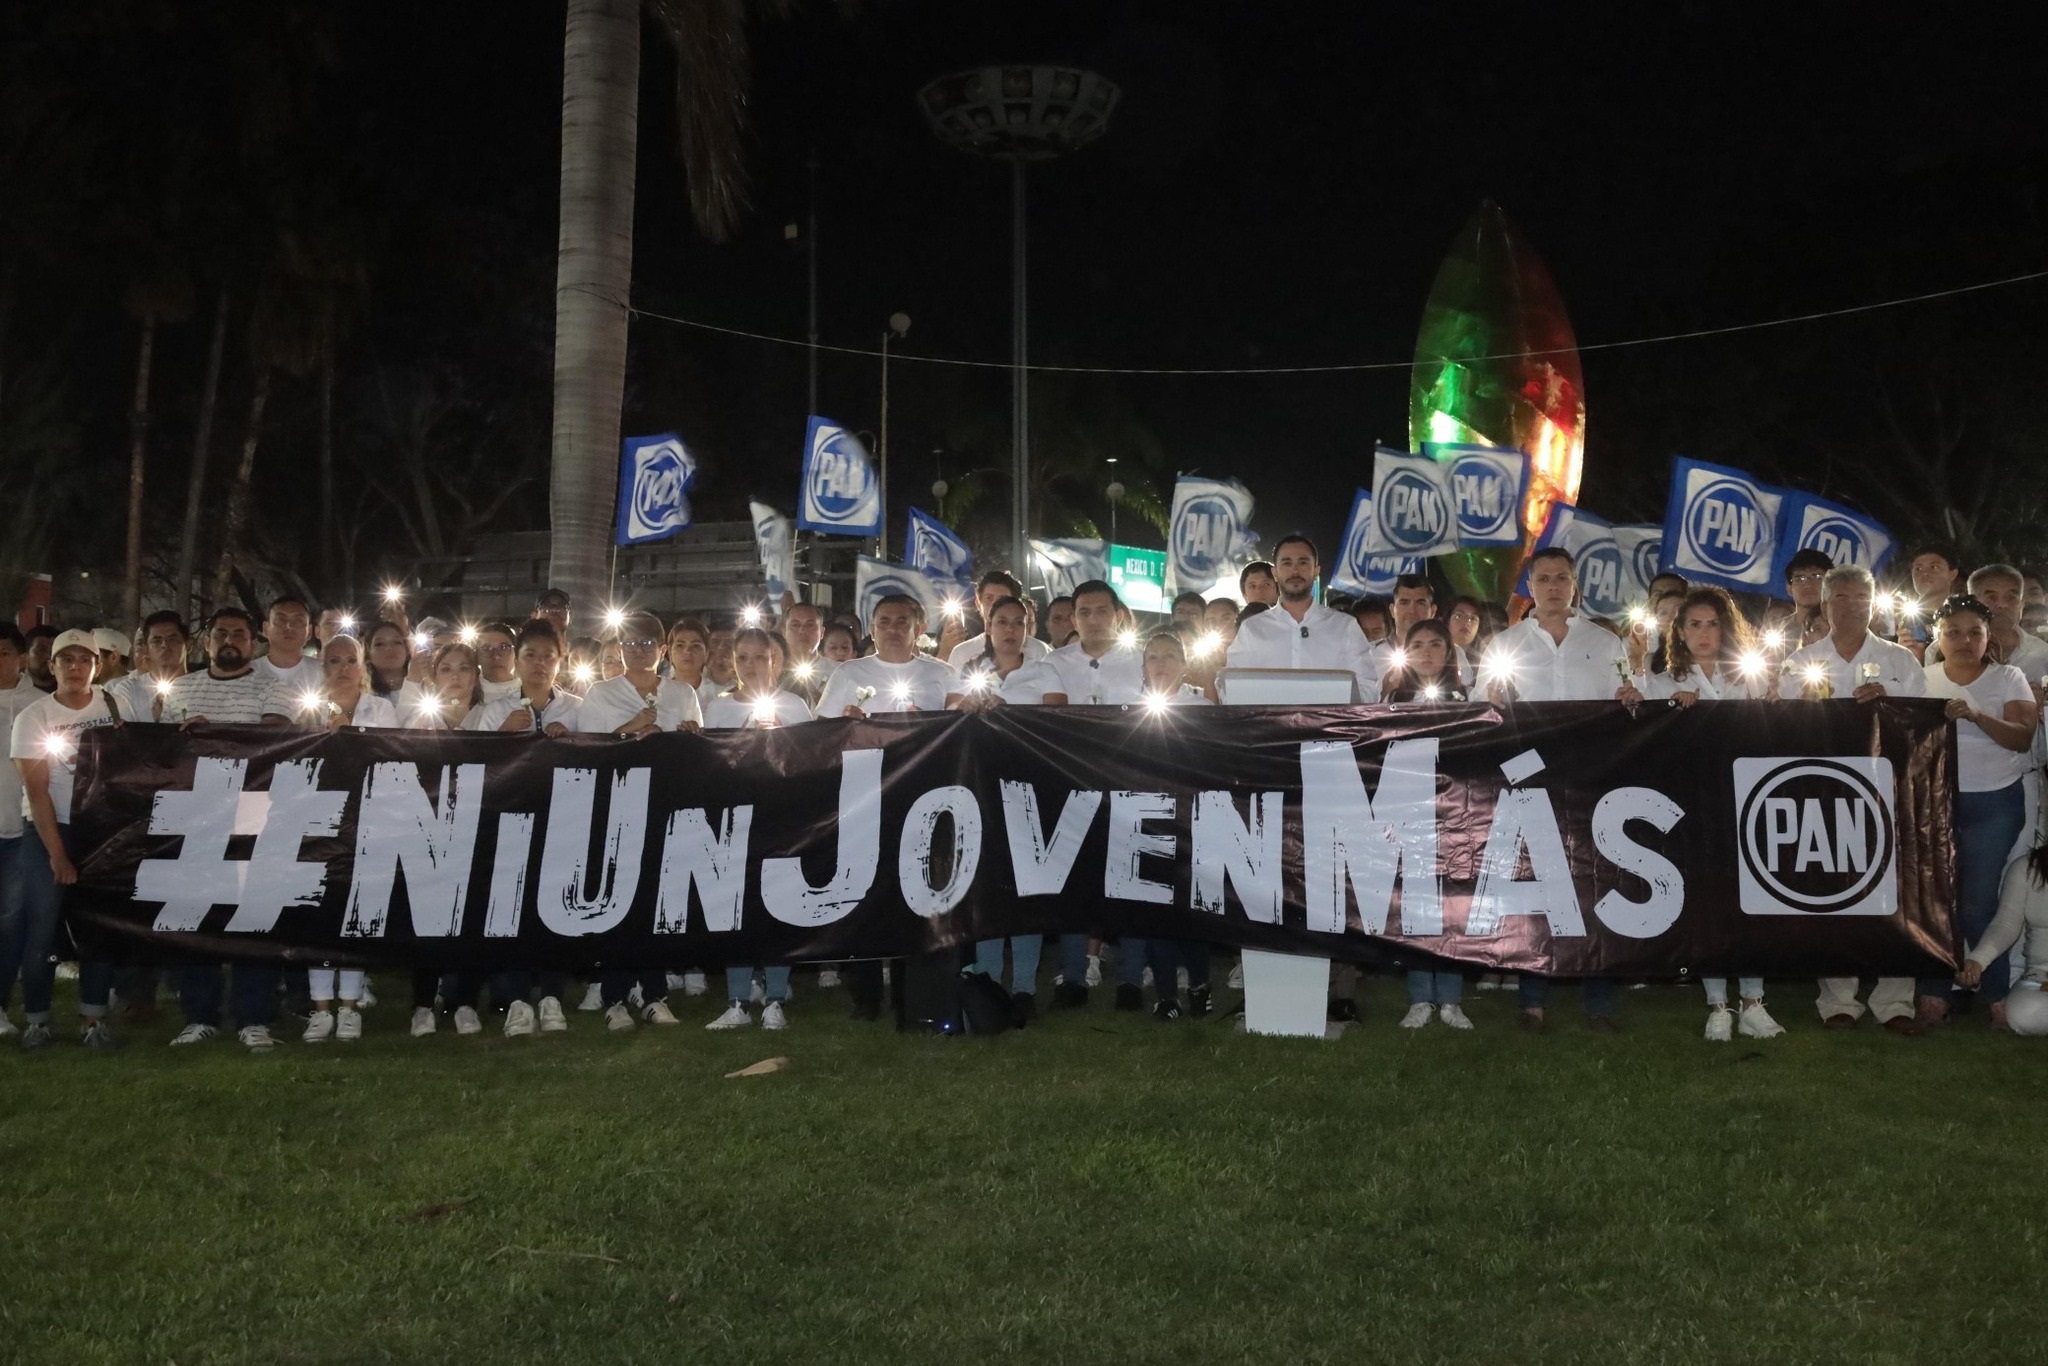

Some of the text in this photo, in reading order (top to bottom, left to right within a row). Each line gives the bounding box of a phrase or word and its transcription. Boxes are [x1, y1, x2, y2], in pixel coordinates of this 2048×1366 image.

[815, 451, 866, 499] PAN
[1454, 474, 1502, 518] PAN
[1389, 484, 1439, 533] PAN
[1699, 498, 1756, 555] PAN
[1182, 512, 1230, 558] PAN
[1126, 558, 1148, 576] MEXICO
[1765, 797, 1869, 874] PAN
